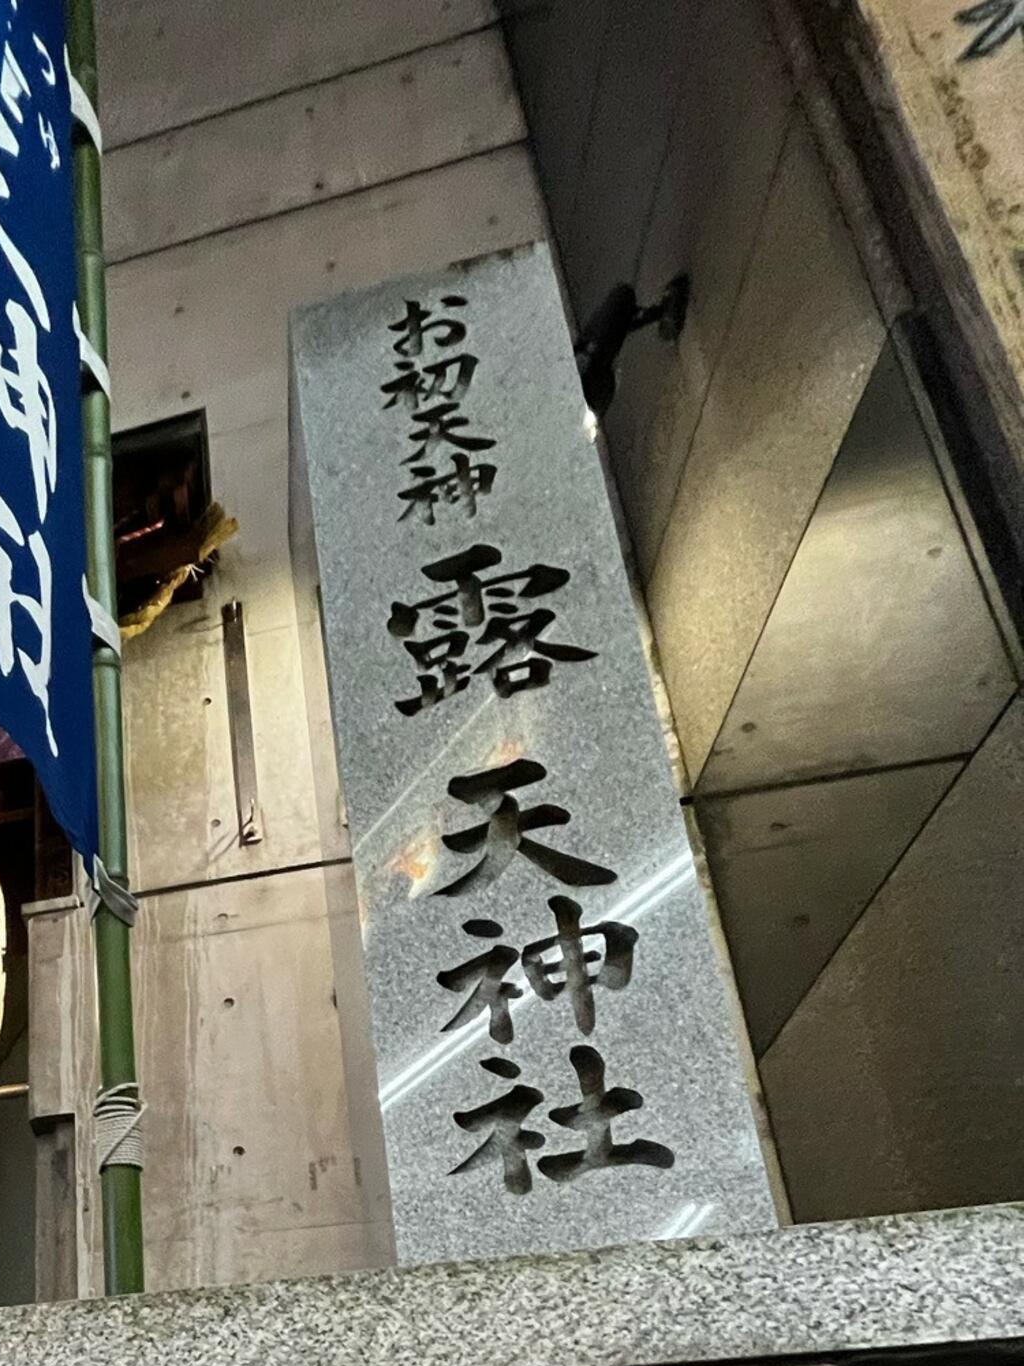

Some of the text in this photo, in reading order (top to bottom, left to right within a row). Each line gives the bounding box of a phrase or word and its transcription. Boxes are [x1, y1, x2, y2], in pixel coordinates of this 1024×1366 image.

[381, 296, 675, 1195] お初天神 露天神社
